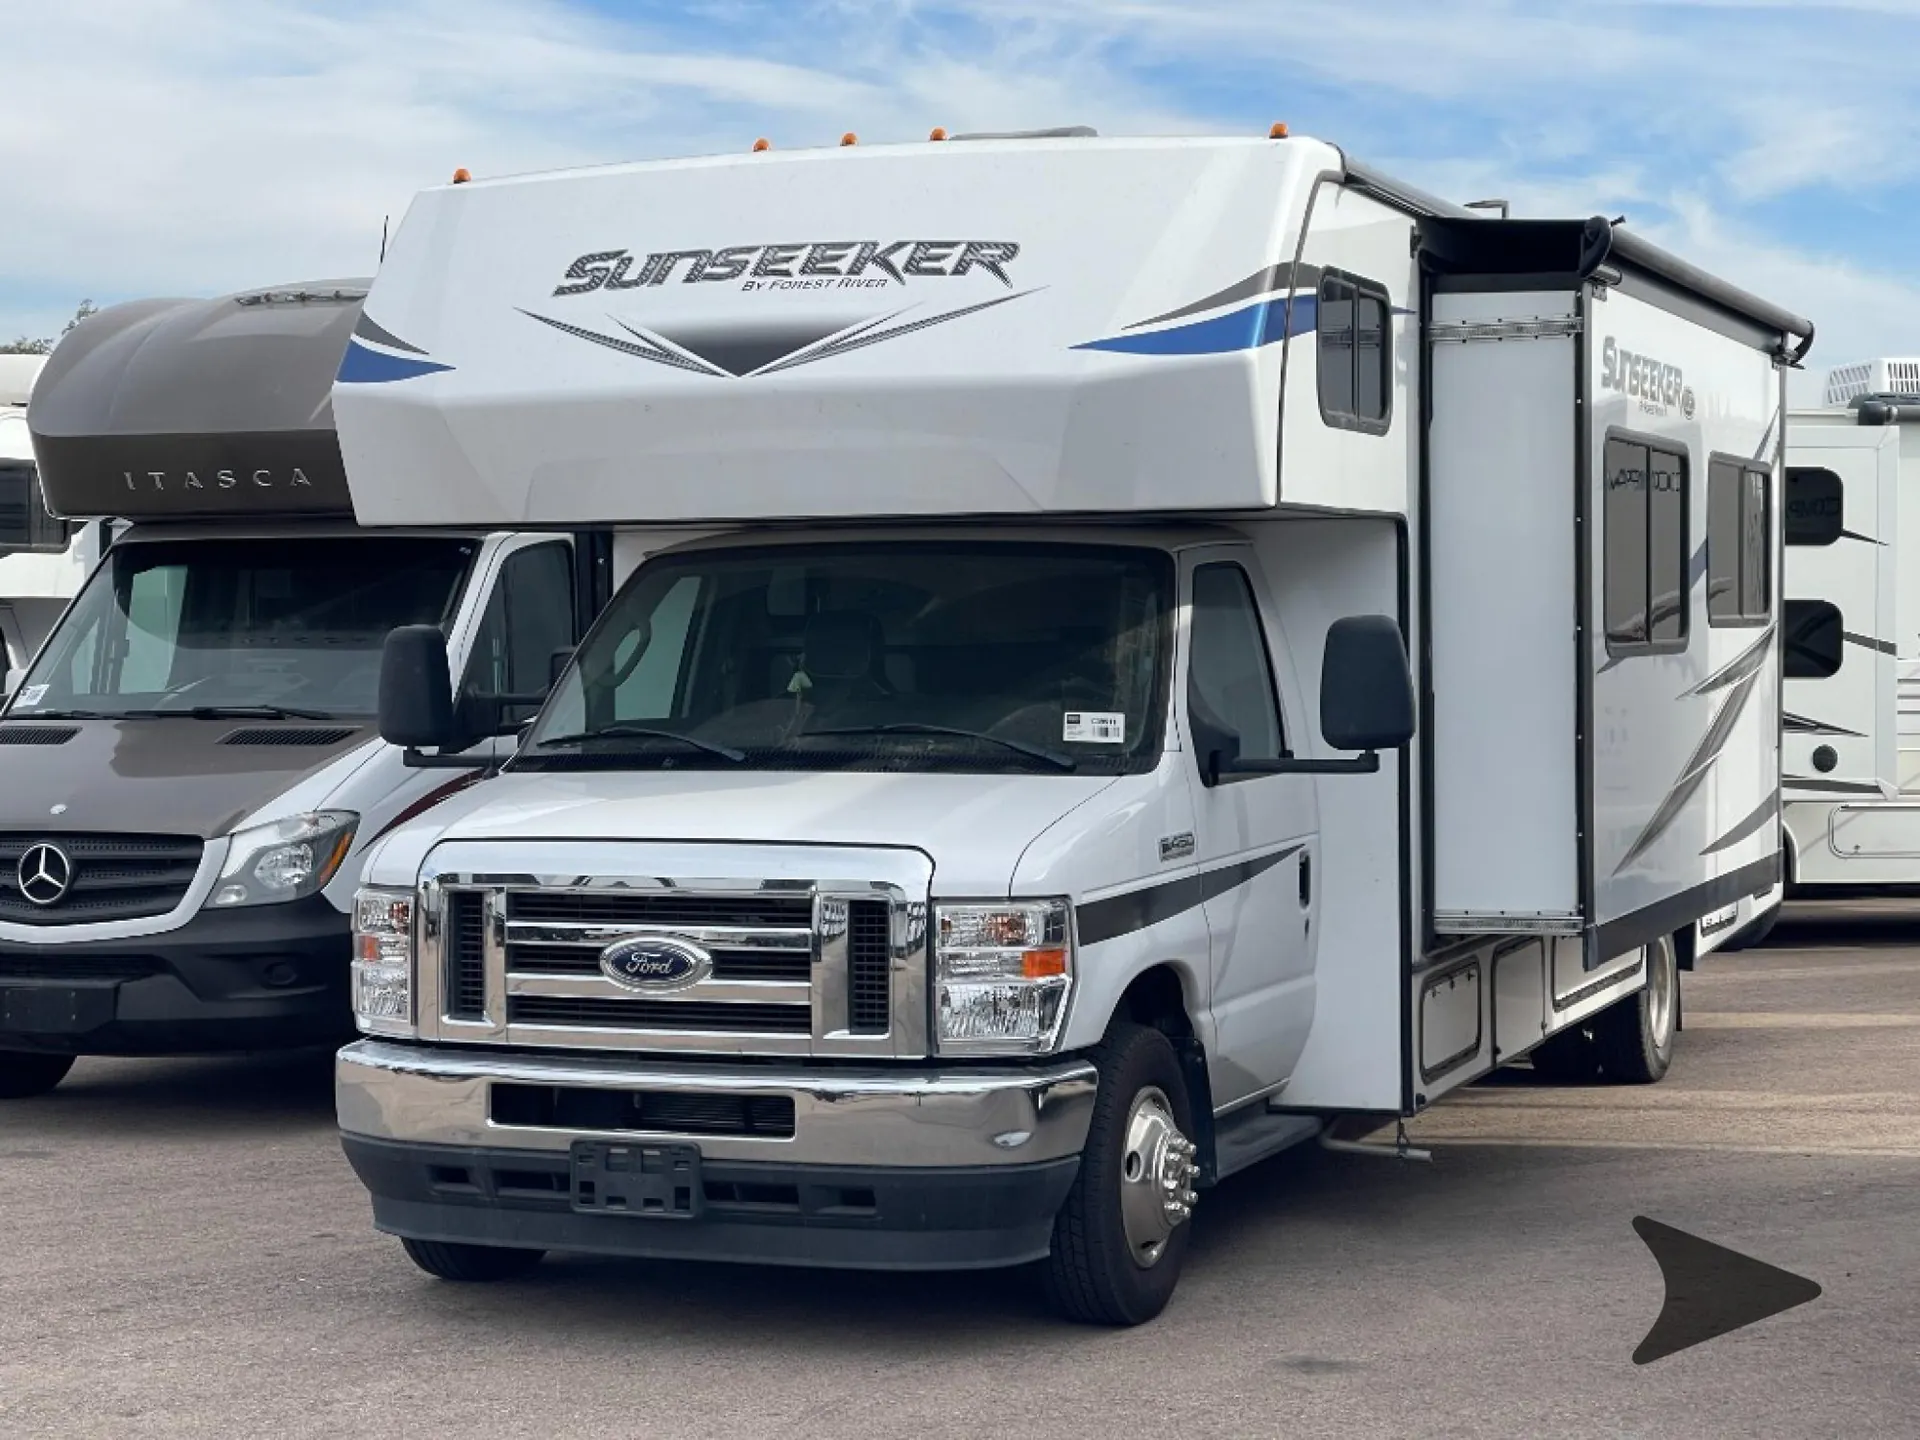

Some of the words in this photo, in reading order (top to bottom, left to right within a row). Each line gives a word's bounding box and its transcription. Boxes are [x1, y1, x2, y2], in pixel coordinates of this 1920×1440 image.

[551, 240, 1020, 297] SUNSEEKER
[742, 280, 765, 291] BY
[769, 279, 834, 290] FOREST
[837, 278, 888, 288] RIVER
[124, 468, 312, 490] ITASCA
[625, 952, 674, 974] Ford
